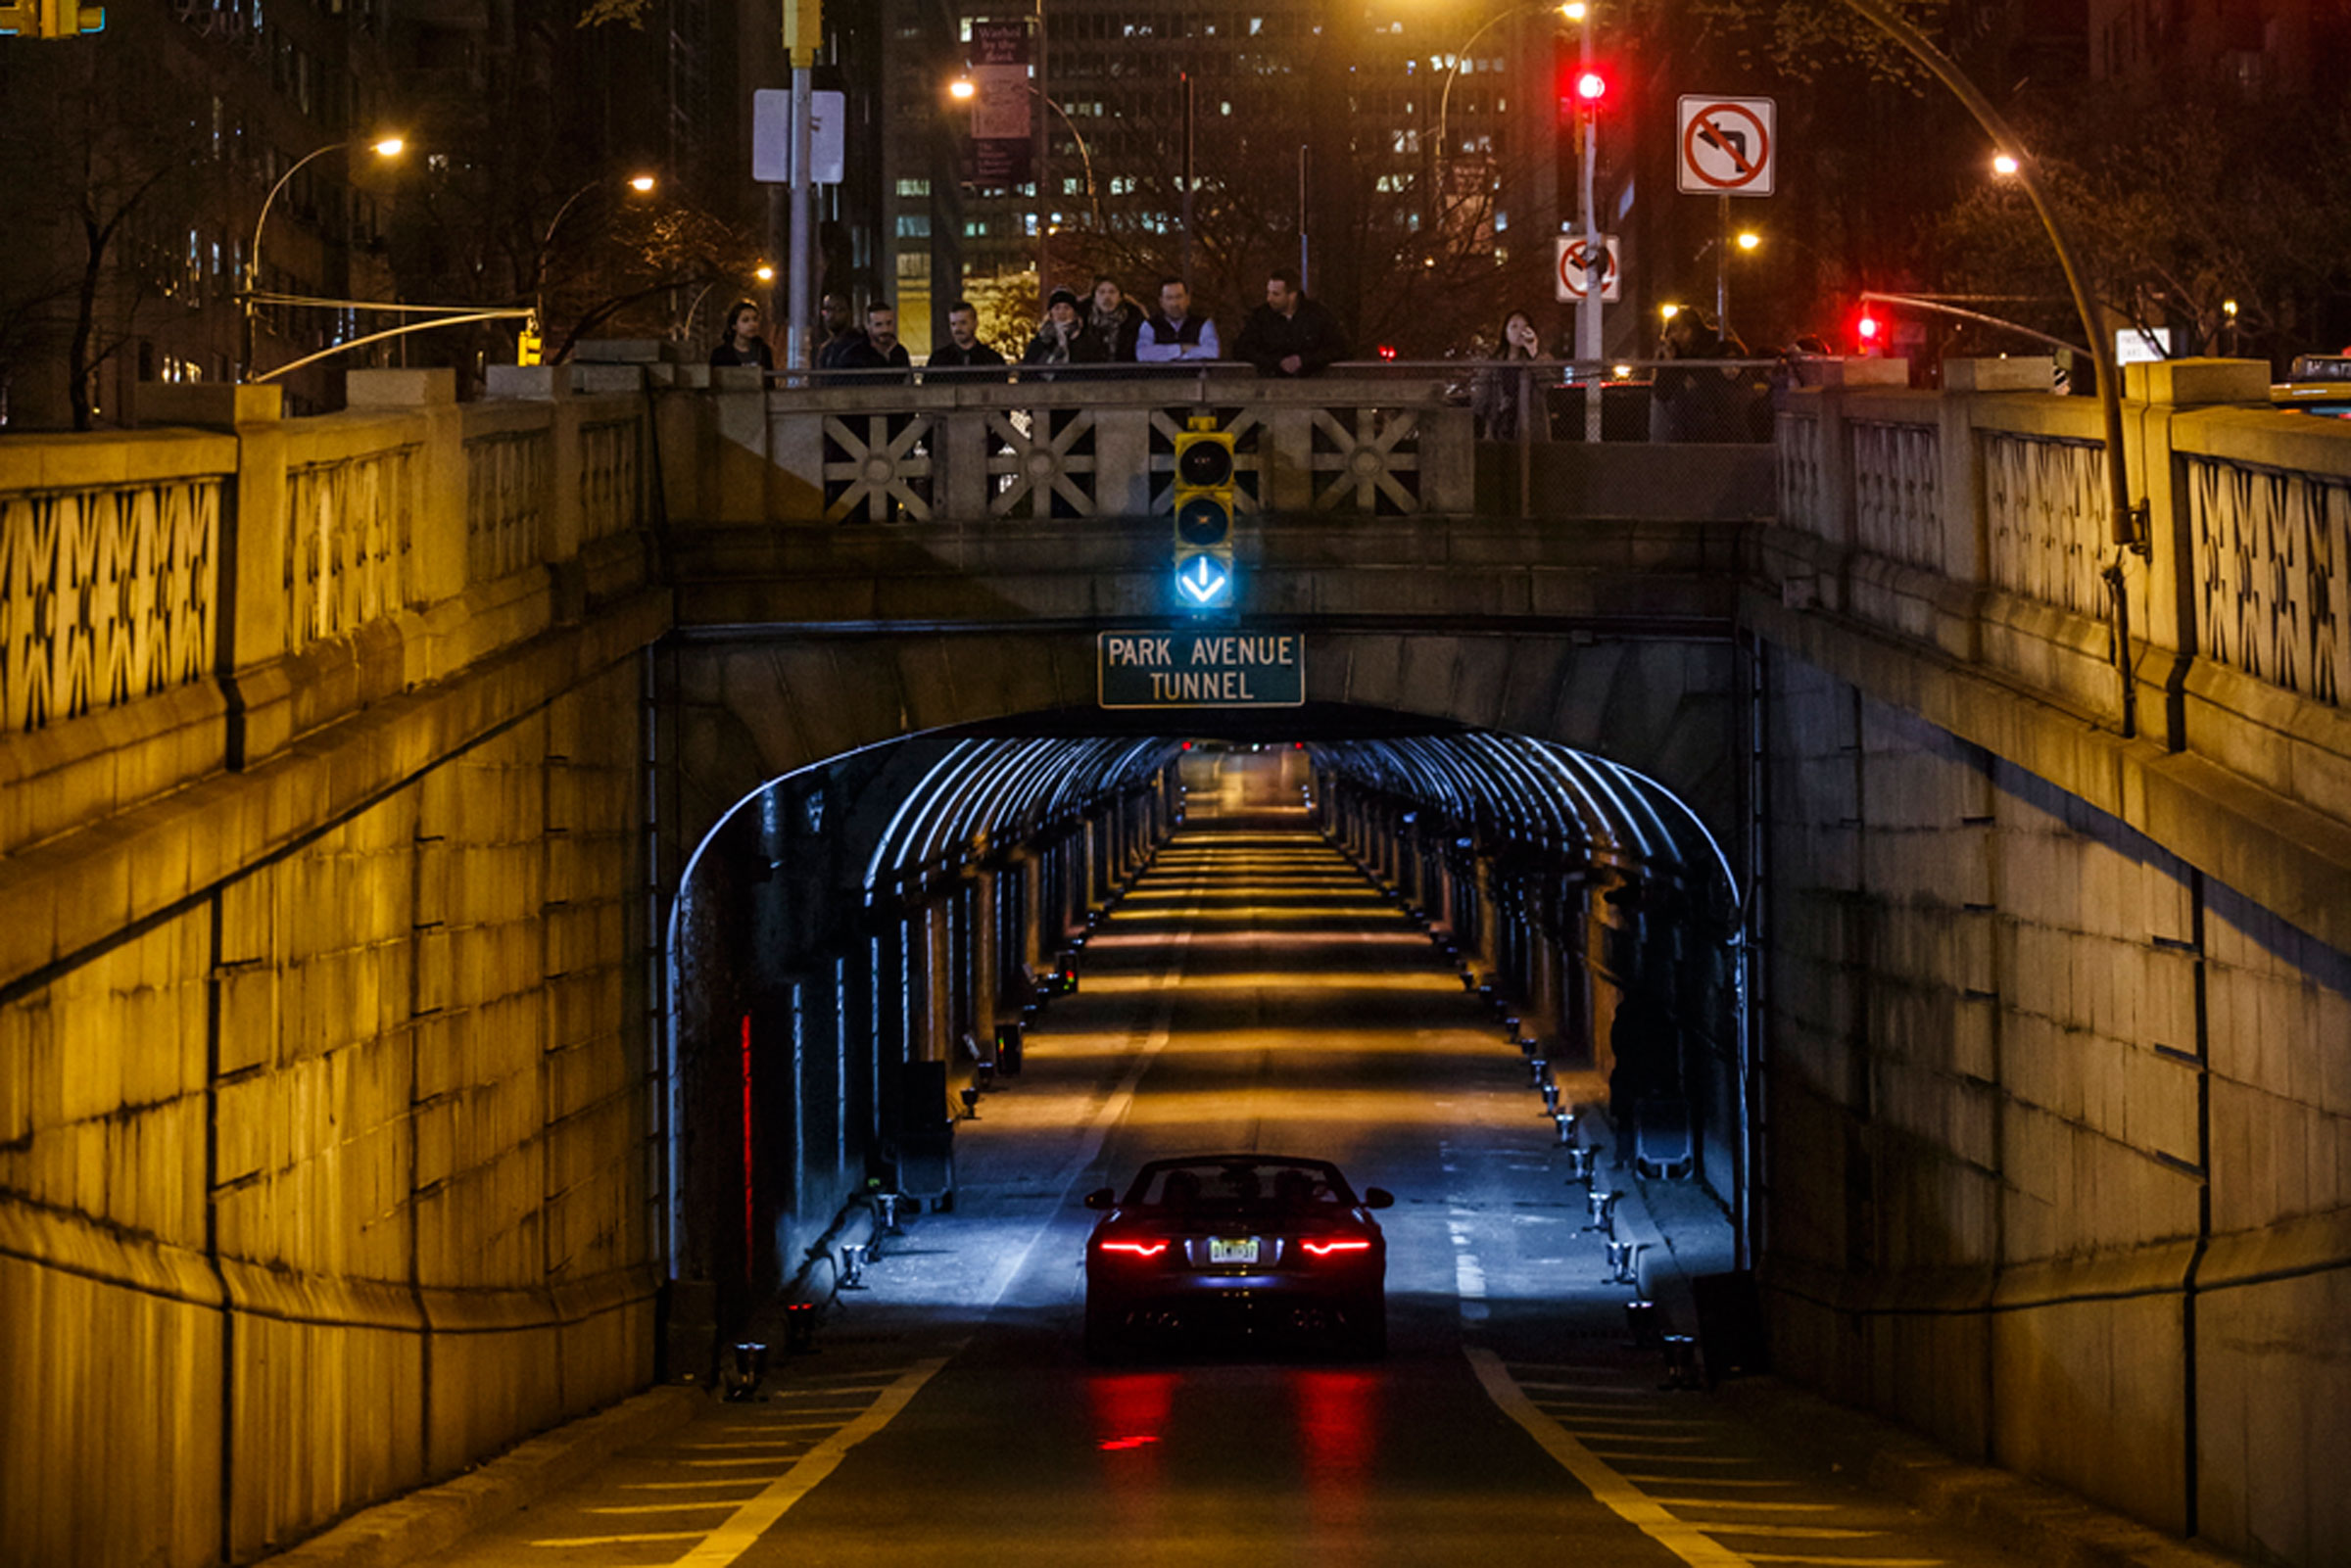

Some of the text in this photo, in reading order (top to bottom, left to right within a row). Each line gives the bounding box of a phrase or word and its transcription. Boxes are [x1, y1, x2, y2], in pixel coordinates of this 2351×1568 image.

[978, 26, 1022, 38] Warhol
[1109, 637, 1293, 666] PARK AVENUE
[1150, 672, 1254, 700] TUNNEL
